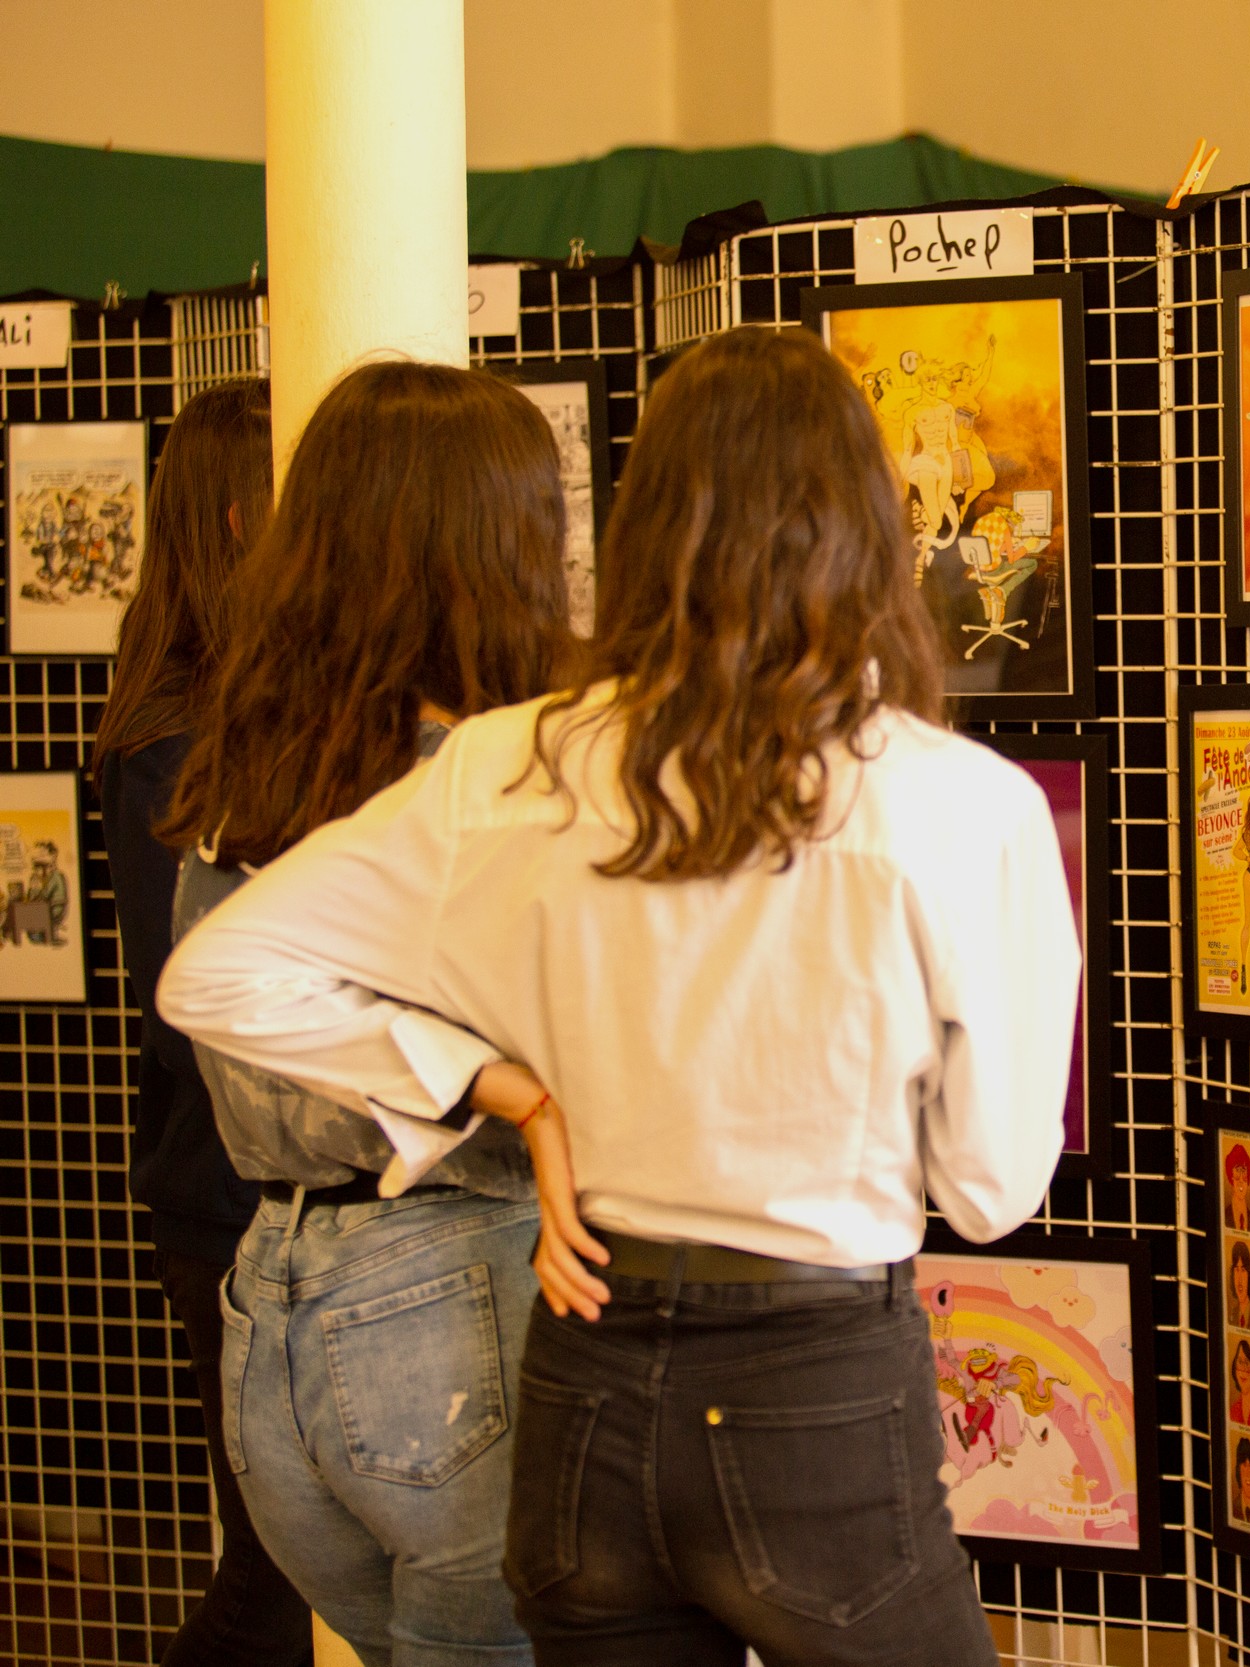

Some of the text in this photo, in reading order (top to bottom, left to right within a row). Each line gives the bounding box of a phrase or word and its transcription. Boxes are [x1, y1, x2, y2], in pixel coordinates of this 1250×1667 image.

[1195, 727, 1225, 739] Dimanche
[1227, 726, 1236, 738] 23
[1203, 746, 1244, 774] Fête de
[1197, 808, 1243, 837] BEYONCE
[1048, 1503, 1064, 1513] The
[1090, 1507, 1110, 1516] Dick
